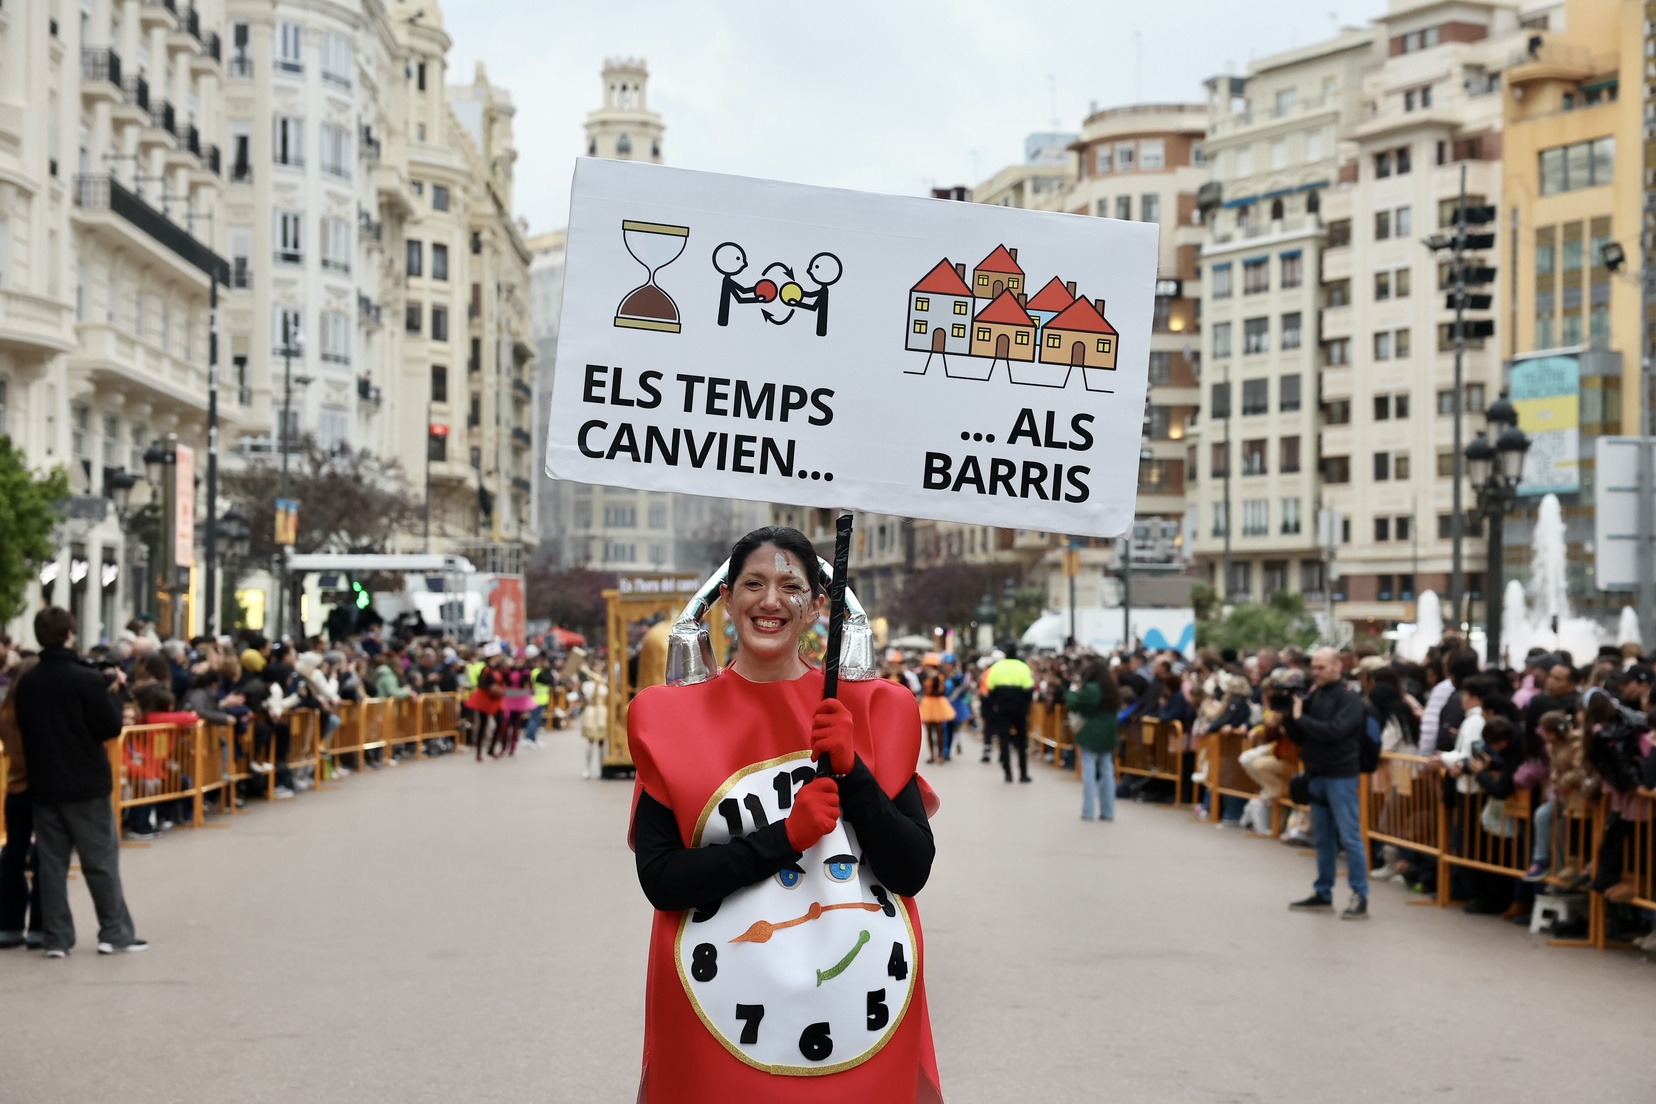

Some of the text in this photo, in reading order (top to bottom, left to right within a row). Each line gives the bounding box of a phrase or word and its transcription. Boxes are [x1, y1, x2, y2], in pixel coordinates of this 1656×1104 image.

[582, 364, 836, 427] ELS TEMPS
[577, 419, 834, 482] CANVIEN...
[1006, 407, 1096, 452] ALS
[922, 451, 1091, 504] BARRIS
[718, 793, 769, 836] 11
[869, 884, 896, 918] 3
[690, 942, 718, 983] 8
[887, 941, 909, 981] 4
[735, 1003, 765, 1045] 7
[866, 987, 890, 1032] 5
[798, 1021, 834, 1062] 6
